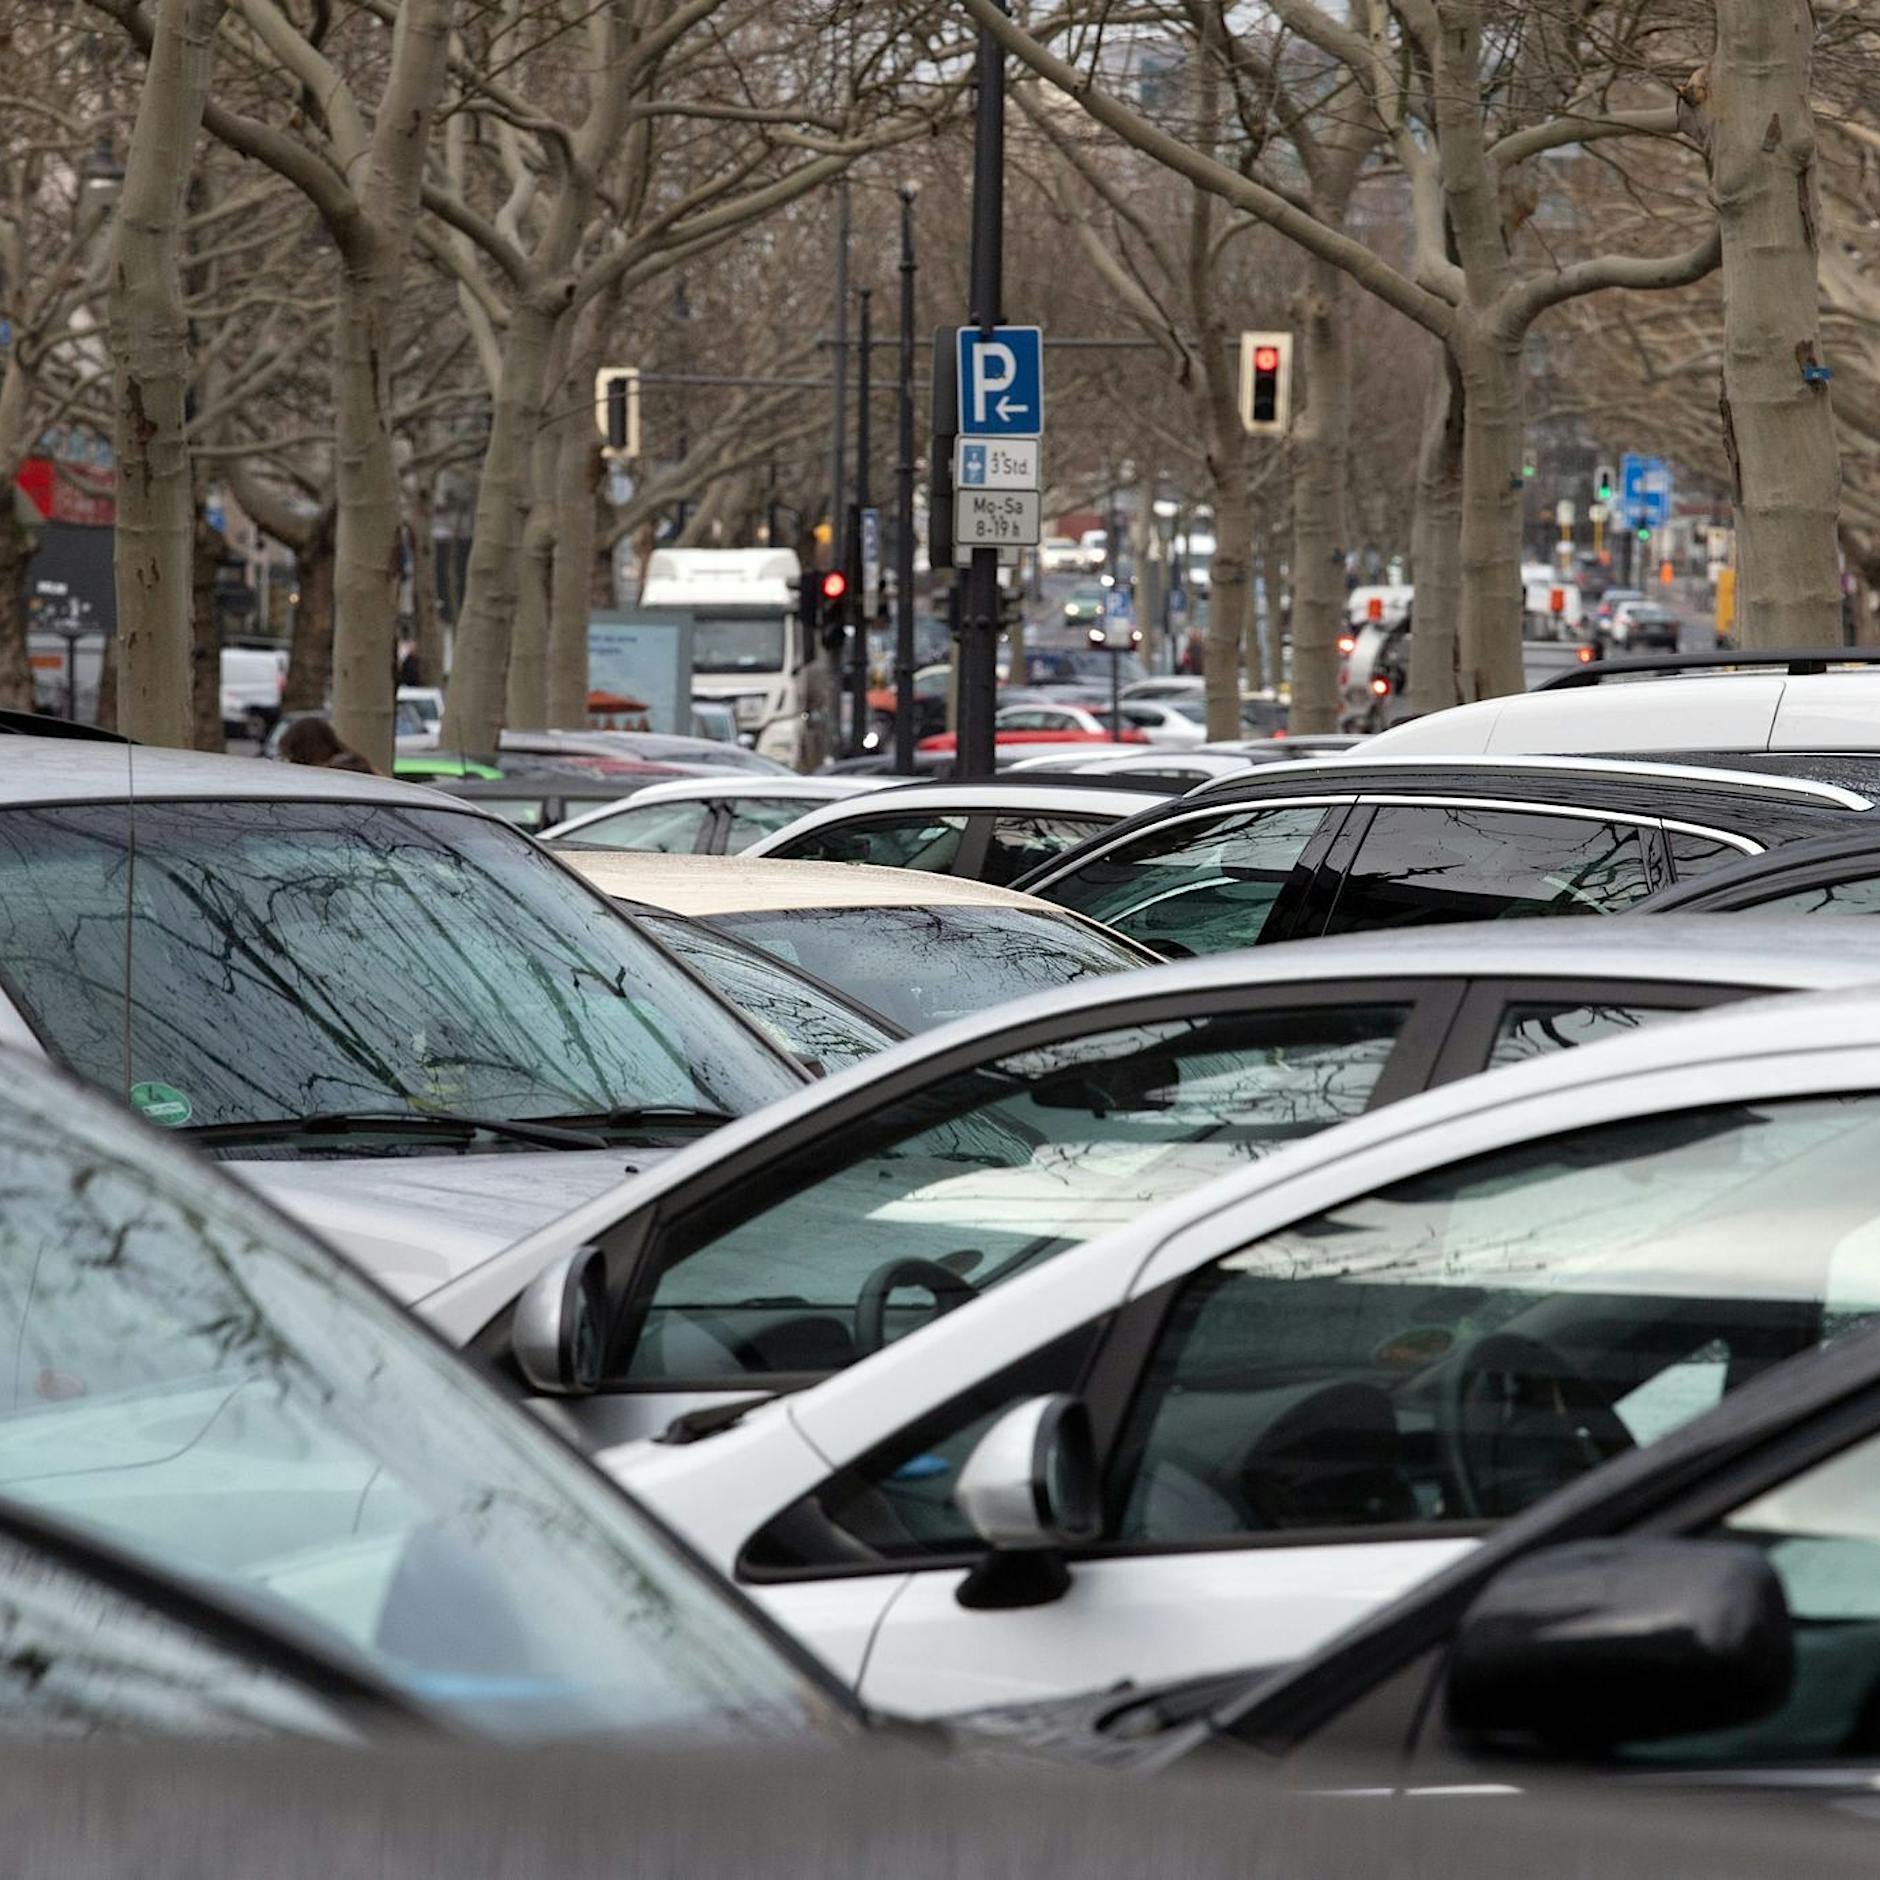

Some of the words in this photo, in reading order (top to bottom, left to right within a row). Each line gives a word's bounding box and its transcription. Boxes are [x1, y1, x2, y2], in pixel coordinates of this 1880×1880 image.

[972, 342, 1017, 423] P
[991, 457, 999, 474] 3
[973, 497, 1024, 514] Mo-Sa
